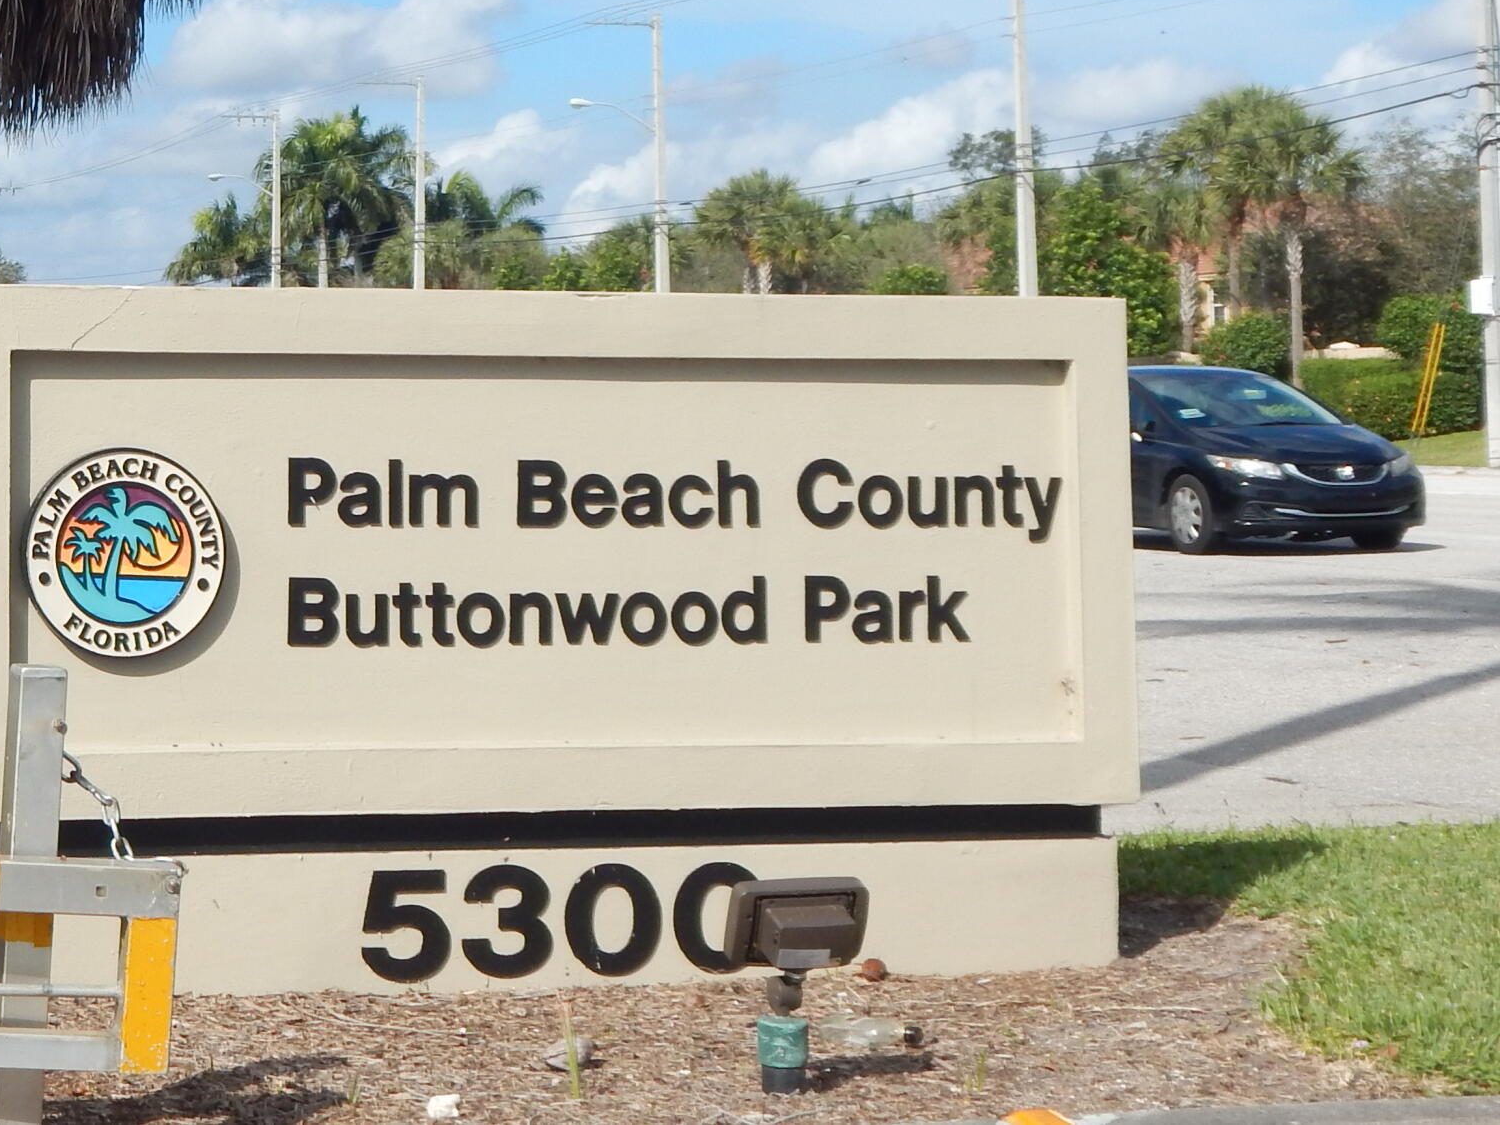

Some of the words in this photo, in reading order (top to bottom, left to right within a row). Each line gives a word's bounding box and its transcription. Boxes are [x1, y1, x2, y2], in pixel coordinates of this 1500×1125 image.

[32, 488, 71, 561] PALM
[71, 458, 161, 491] BEACH
[164, 473, 220, 571] COUNTY
[287, 457, 479, 529] Palm
[516, 459, 760, 529] Beach
[797, 458, 1061, 543] County
[63, 613, 181, 652] FLORIDA
[287, 575, 767, 648] Buttonwood
[804, 575, 970, 644] Park
[361, 861, 759, 983] 5300
